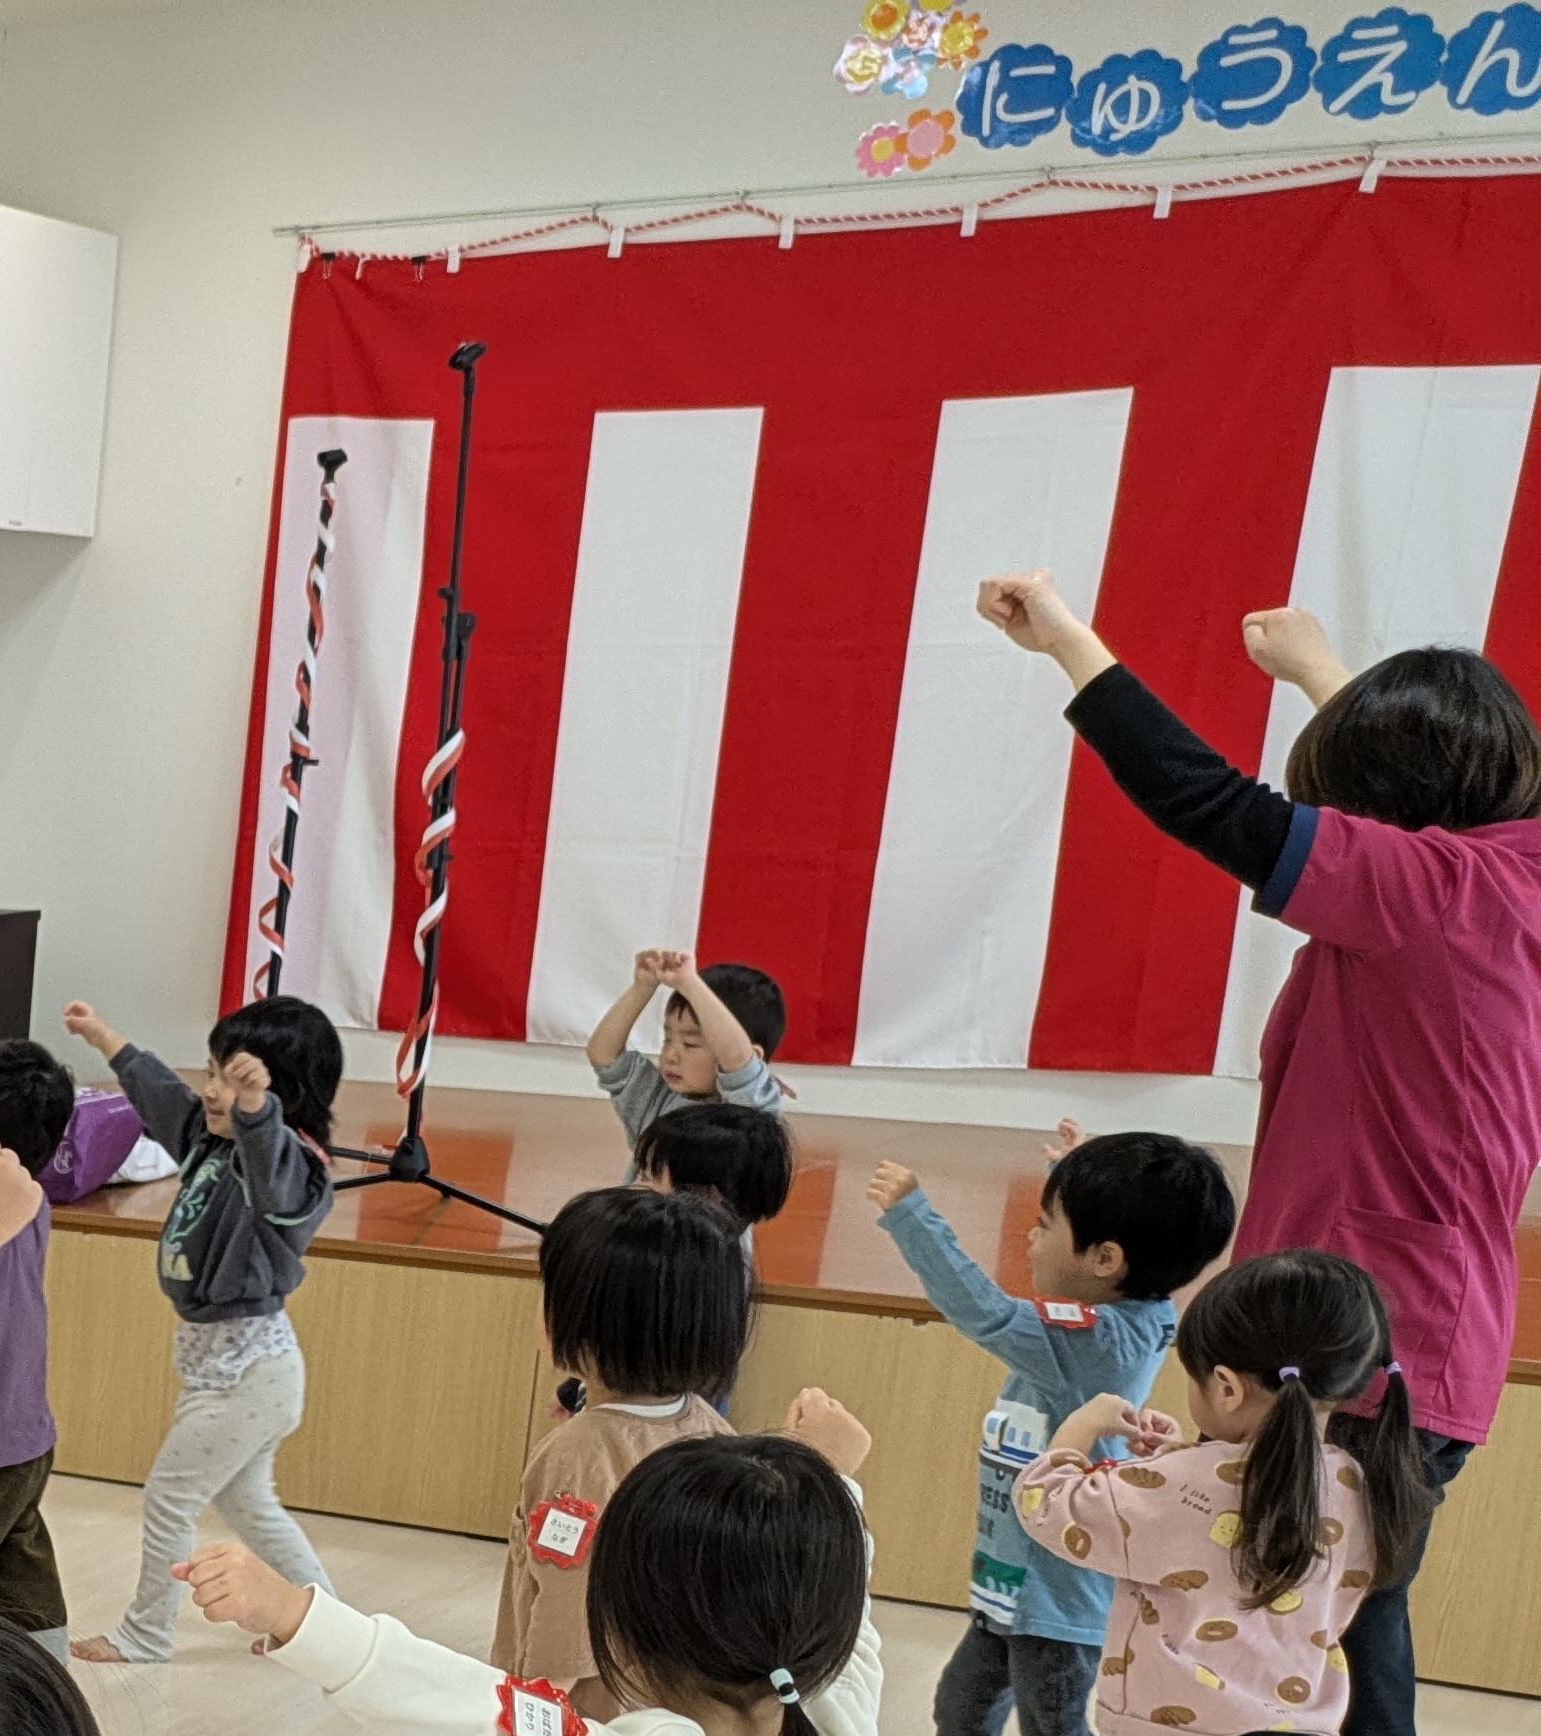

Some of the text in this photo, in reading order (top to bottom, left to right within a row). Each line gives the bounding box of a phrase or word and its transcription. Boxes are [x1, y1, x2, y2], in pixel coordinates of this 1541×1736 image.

[983, 19, 1541, 141] にゅうえん
[525, 1702, 535, 1731] ひかり
